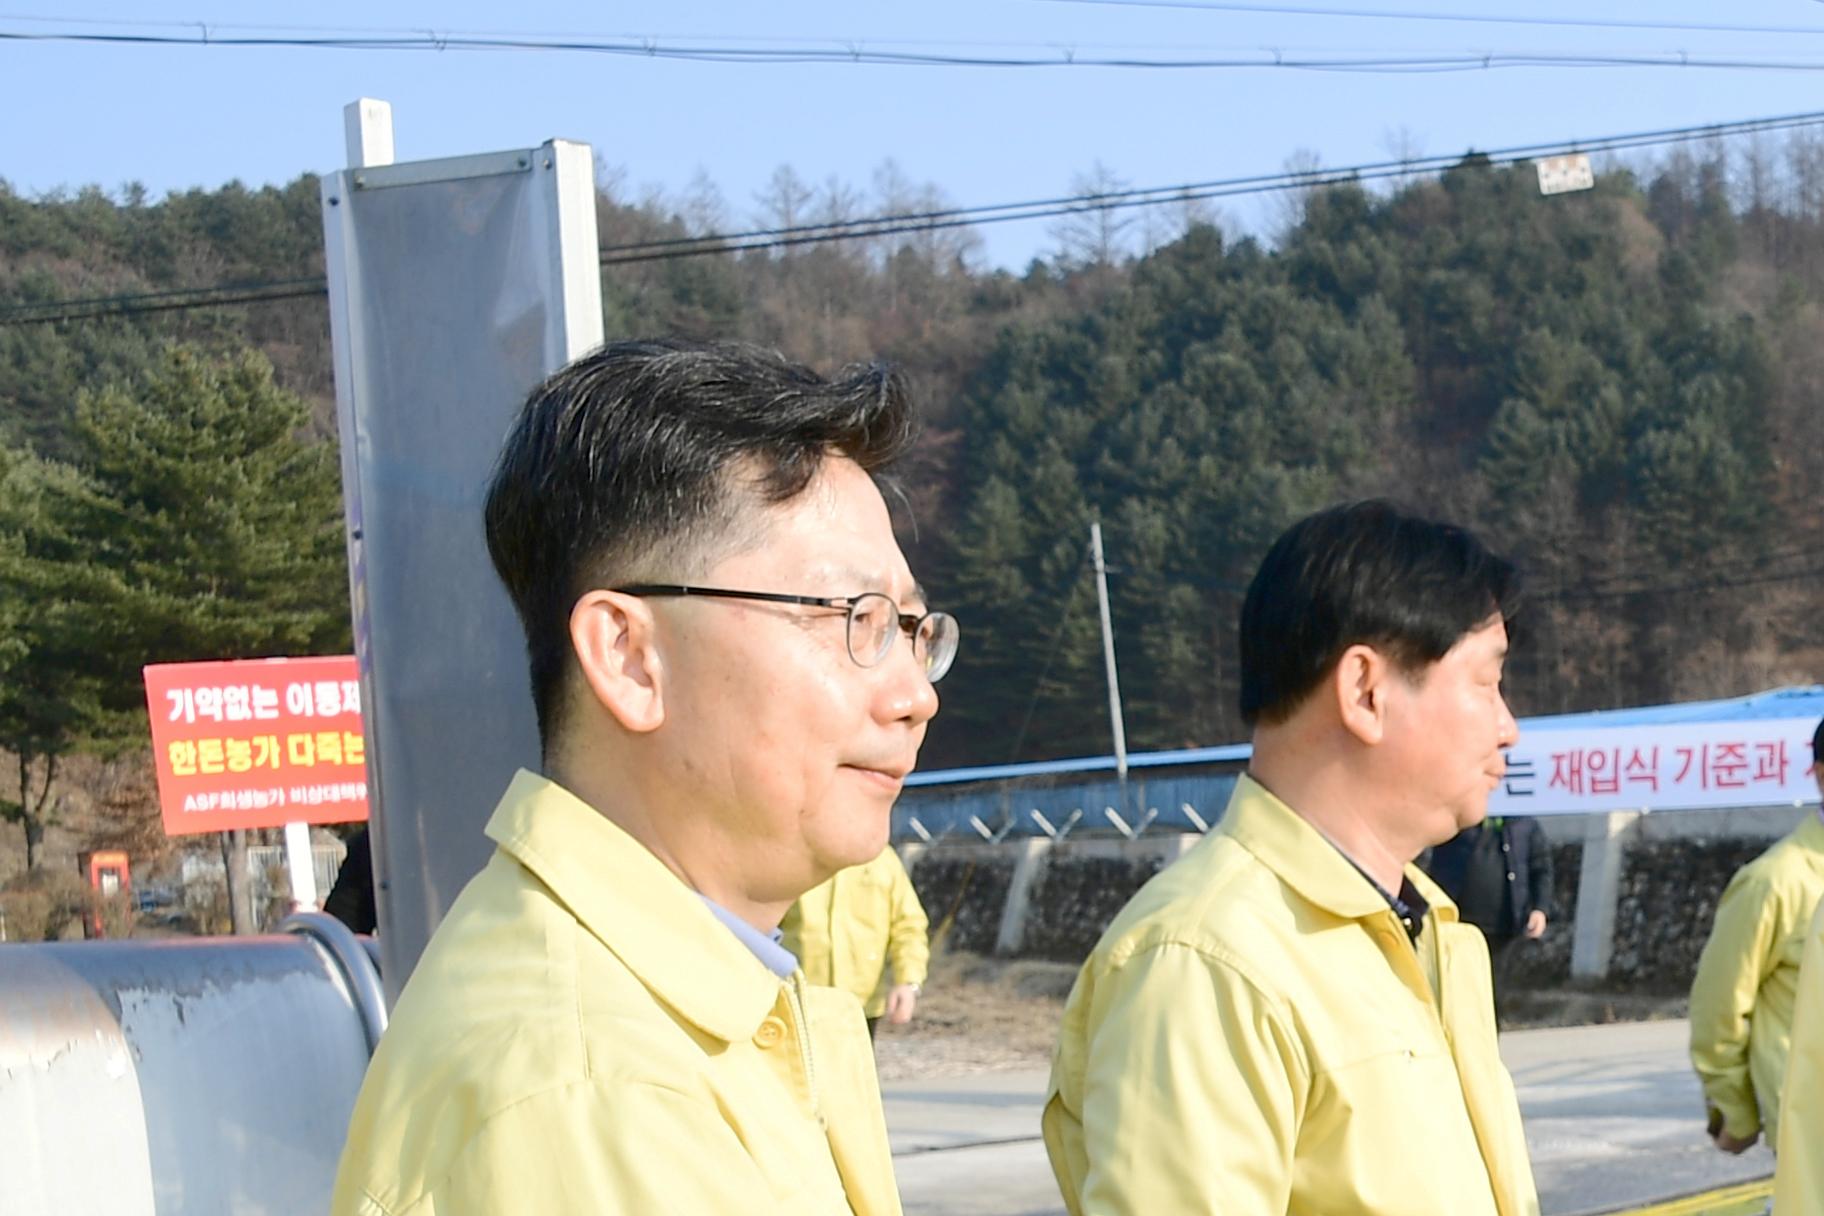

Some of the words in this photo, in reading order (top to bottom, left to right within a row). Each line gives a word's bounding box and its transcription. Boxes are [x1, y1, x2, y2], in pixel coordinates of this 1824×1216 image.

[166, 685, 279, 724] 기약없는
[168, 735, 281, 776] 한돈농가
[287, 731, 366, 768] 다죽는
[1547, 747, 1662, 796] 재입식
[1673, 740, 1790, 790] 기준과
